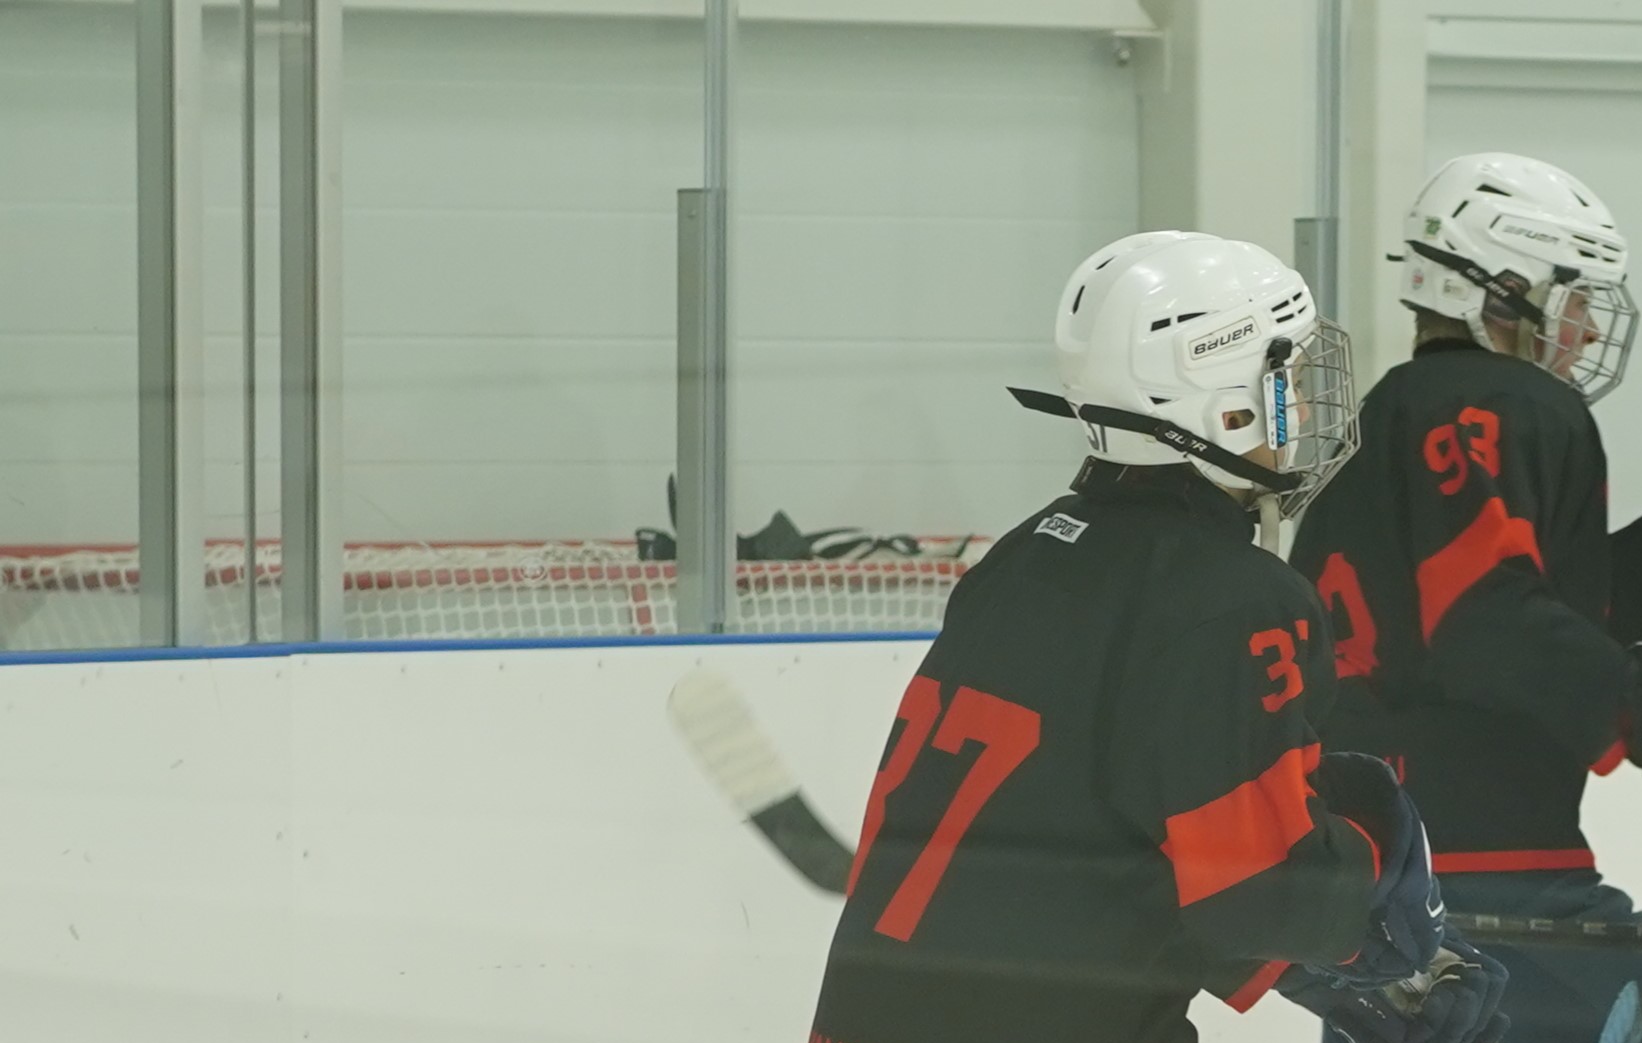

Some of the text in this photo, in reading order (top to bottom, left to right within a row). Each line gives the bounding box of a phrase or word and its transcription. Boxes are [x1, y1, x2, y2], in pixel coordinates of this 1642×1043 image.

[1194, 323, 1254, 355] BAUER
[1423, 406, 1500, 496] 93
[1249, 619, 1308, 713] 3
